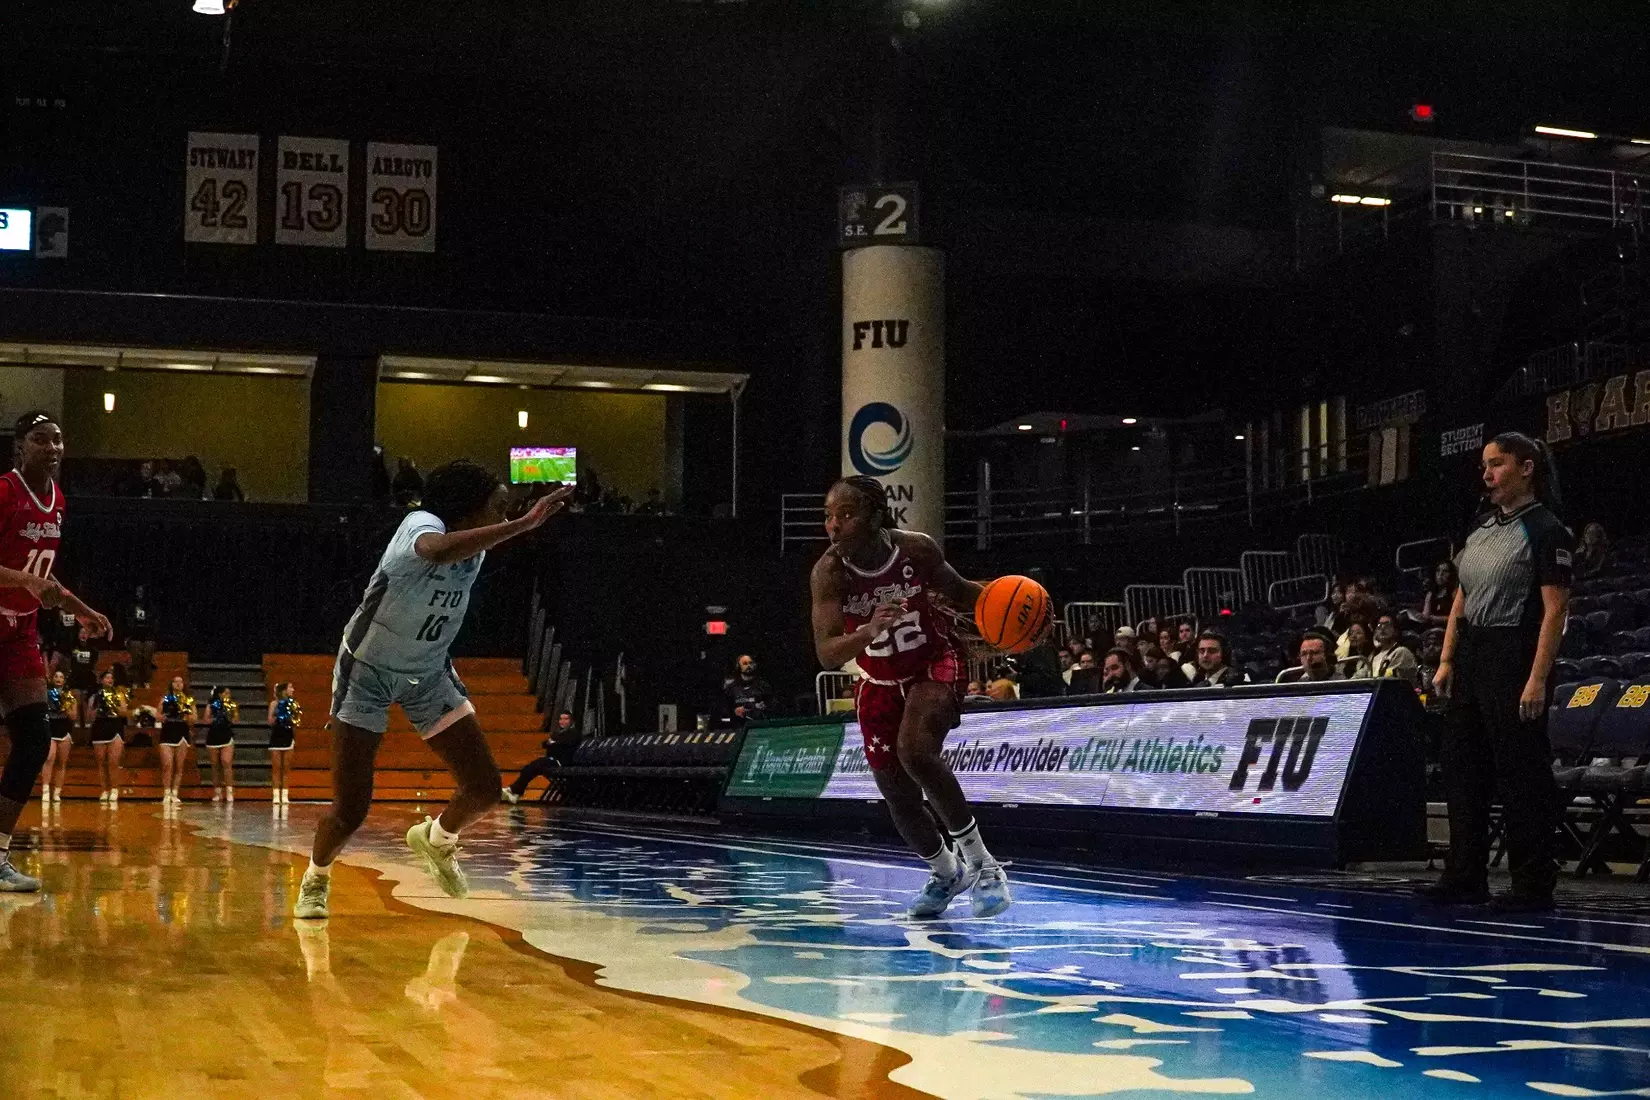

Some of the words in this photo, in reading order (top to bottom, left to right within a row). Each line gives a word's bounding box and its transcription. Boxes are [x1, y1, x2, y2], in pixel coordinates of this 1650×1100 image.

[190, 147, 257, 169] STEWART
[283, 151, 344, 173] BELL
[372, 156, 433, 178] ARROYO
[191, 178, 248, 228] 42
[281, 181, 343, 232] 13
[371, 187, 431, 237] 30
[874, 194, 907, 235] 2
[853, 319, 910, 350] FIU
[1440, 422, 1485, 443] STUDENT
[1440, 438, 1483, 457] SECTION
[22, 549, 56, 580] 10
[428, 589, 463, 608] FIU
[938, 739, 994, 773] edicine
[993, 737, 1069, 773] Provider
[1068, 737, 1094, 772] of
[1089, 737, 1126, 772] FIU
[1122, 733, 1226, 774] Athletics
[1229, 716, 1331, 792] FIU
